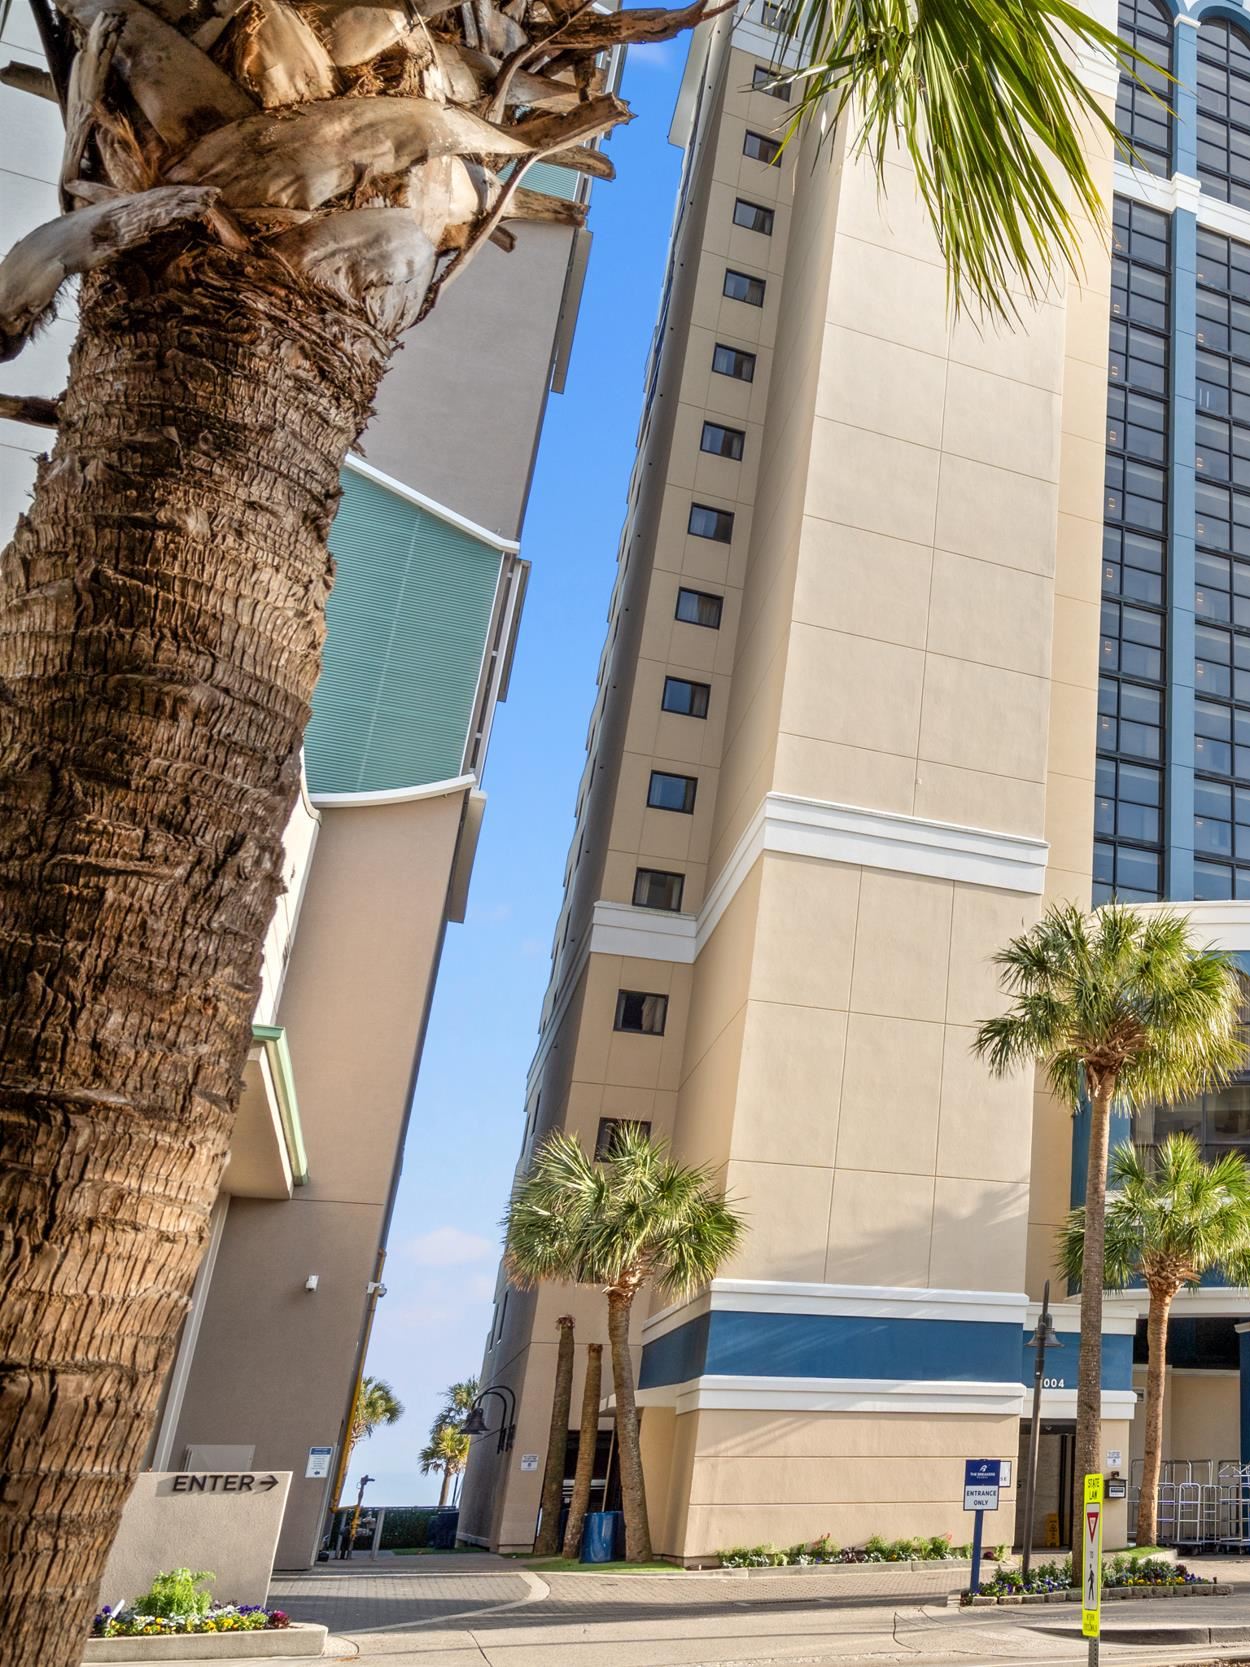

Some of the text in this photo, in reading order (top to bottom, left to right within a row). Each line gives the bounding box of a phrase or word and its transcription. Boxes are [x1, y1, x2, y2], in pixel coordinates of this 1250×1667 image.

[172, 1474, 255, 1491] ENTER
[1088, 1478, 1100, 1488] STATE
[1089, 1490, 1098, 1500] LAW
